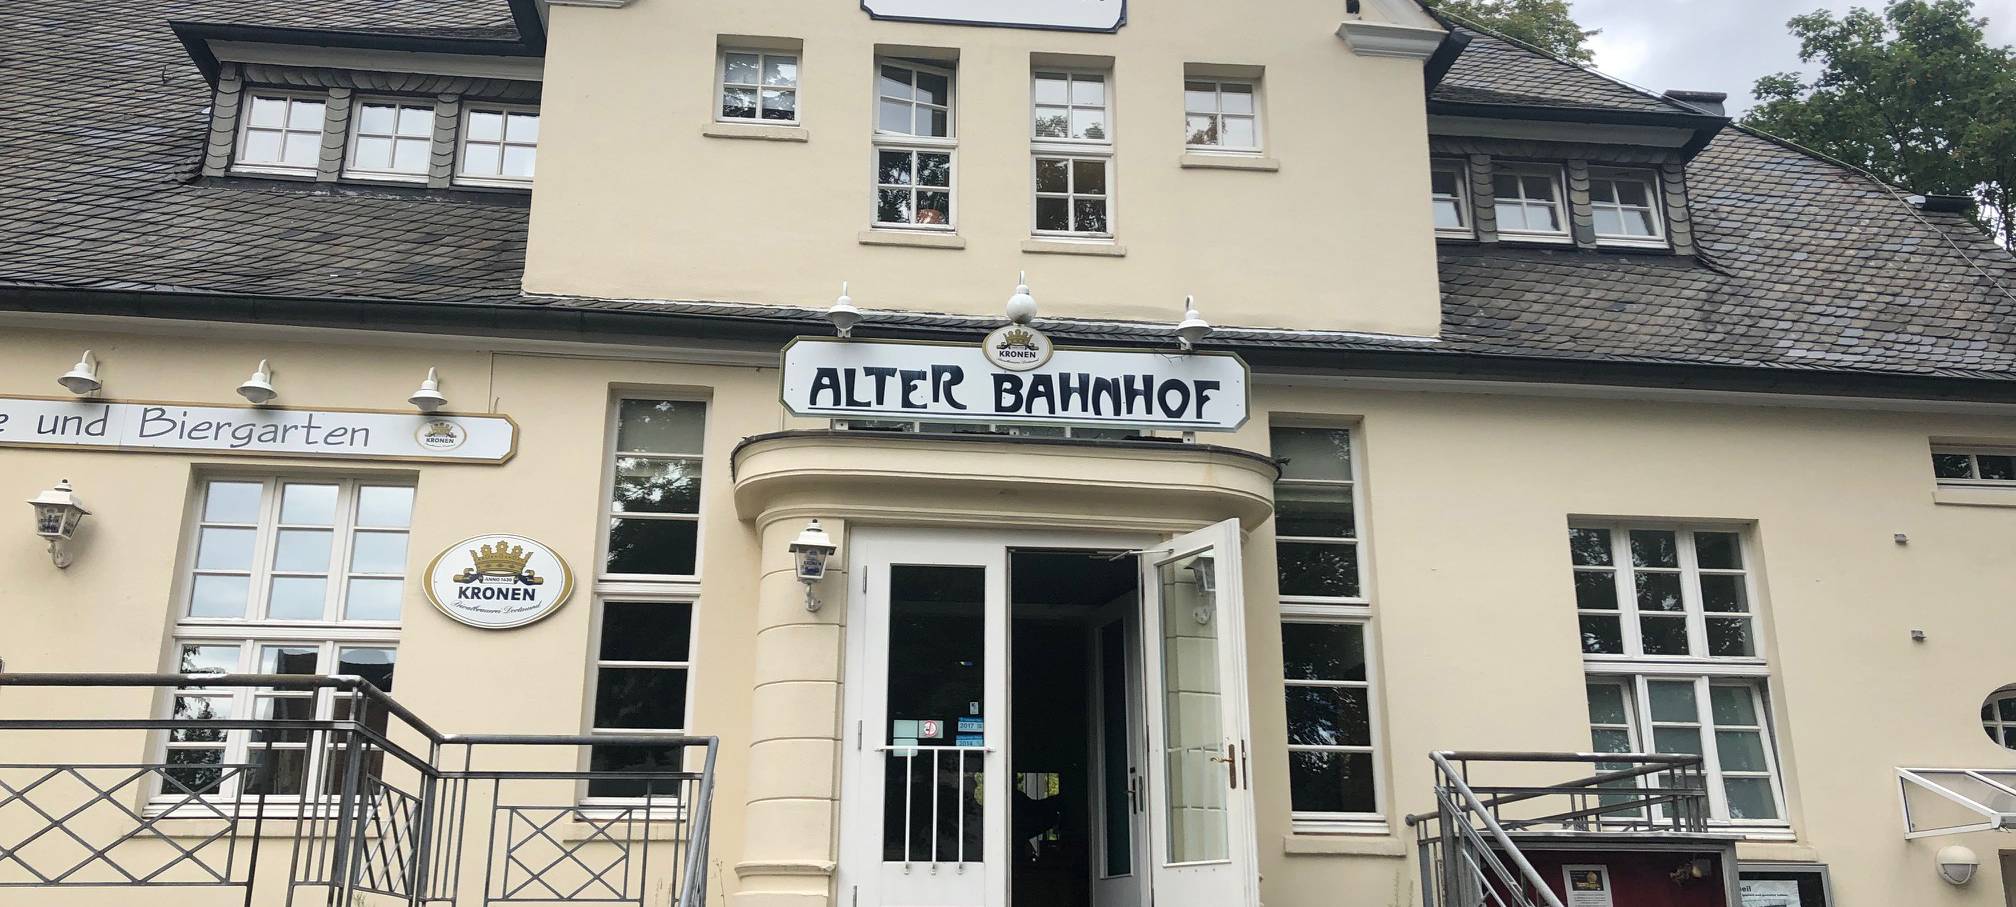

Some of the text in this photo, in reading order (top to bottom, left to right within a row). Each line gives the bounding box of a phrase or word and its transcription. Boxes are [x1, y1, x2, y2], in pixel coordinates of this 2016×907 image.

[999, 350, 1036, 358] KRONEN
[809, 364, 1221, 419] ALTER BAHNHOF
[37, 405, 110, 437] und
[139, 407, 370, 448] Biergarten
[458, 586, 535, 601] KRONEN
